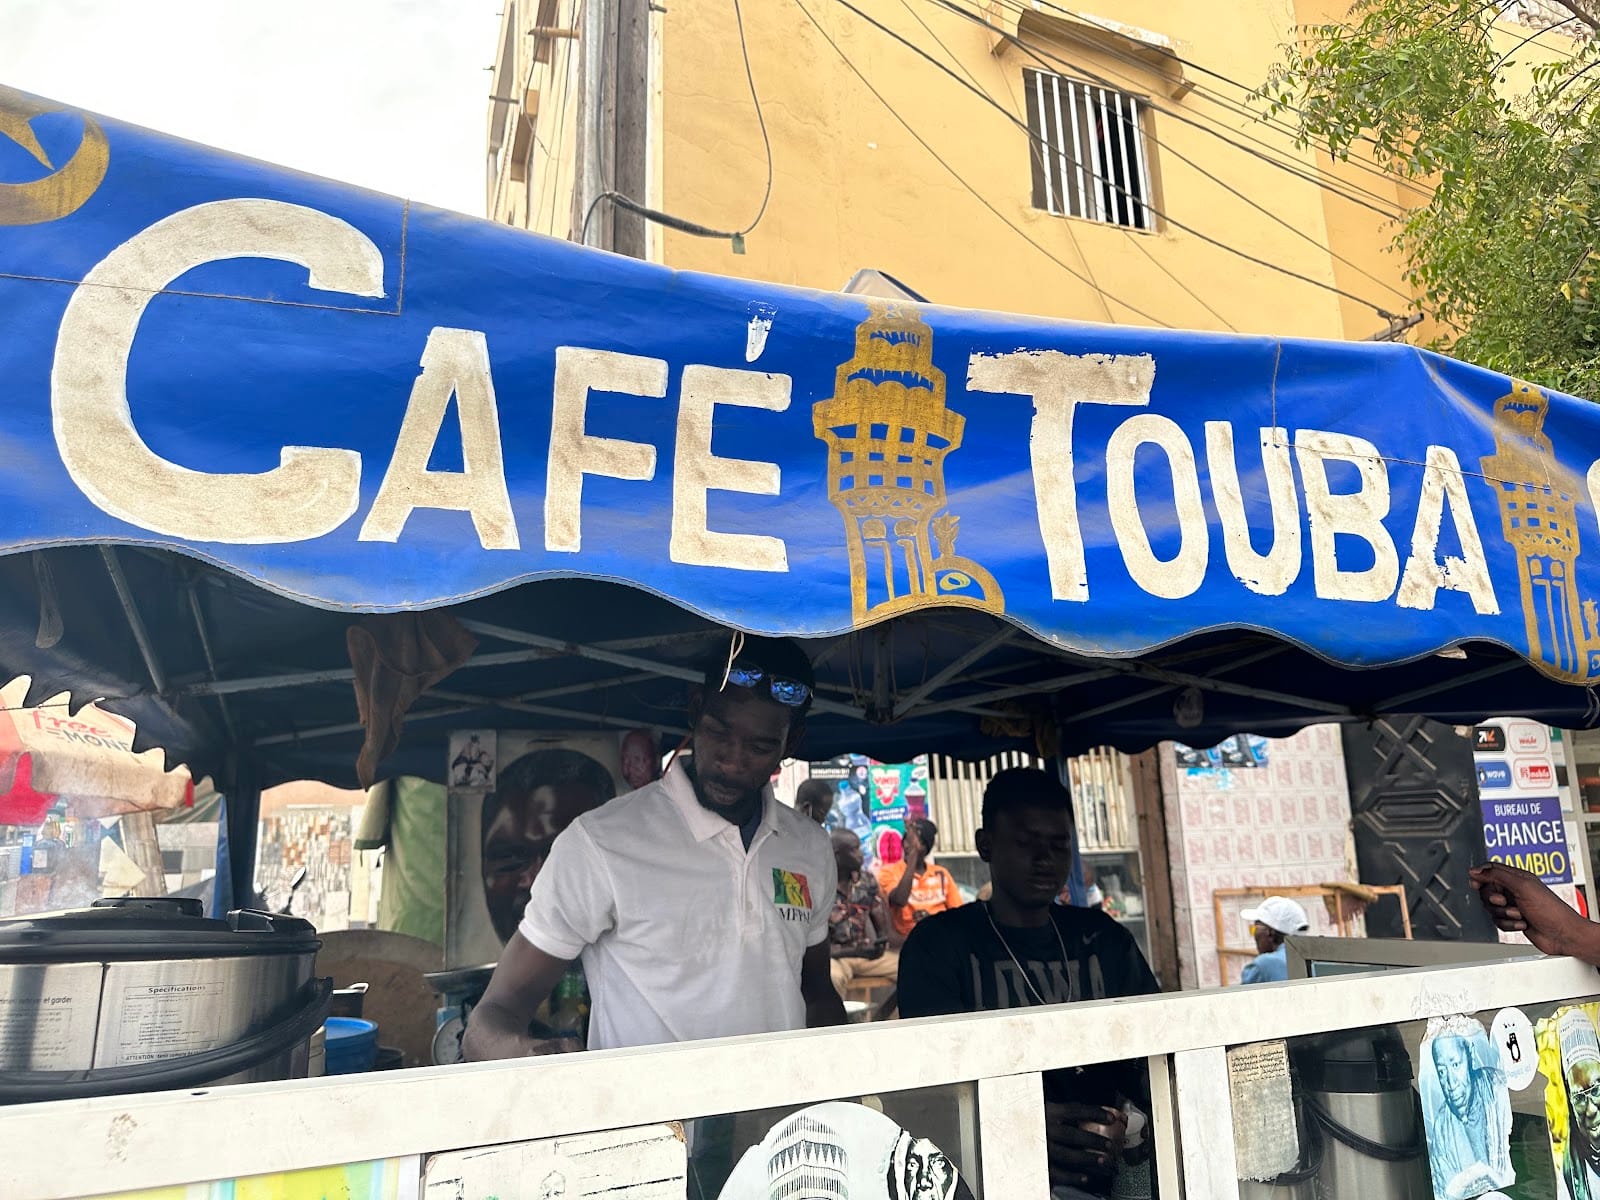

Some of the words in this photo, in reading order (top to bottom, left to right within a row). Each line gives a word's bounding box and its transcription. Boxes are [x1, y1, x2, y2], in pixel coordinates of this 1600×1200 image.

[966, 347, 1501, 616] TOUBA
[1494, 803, 1529, 817] BUREAU
[1530, 802, 1542, 815] DE
[1483, 820, 1564, 848] CHANGE
